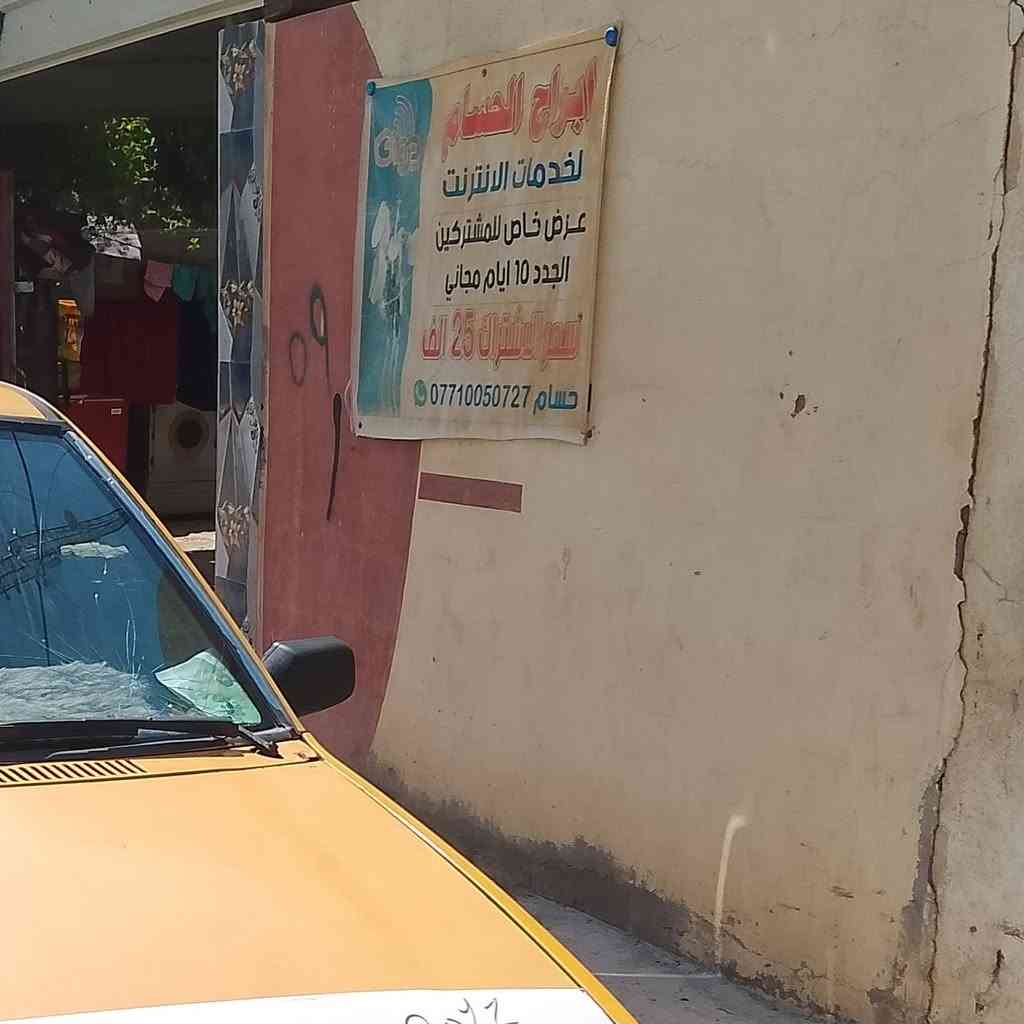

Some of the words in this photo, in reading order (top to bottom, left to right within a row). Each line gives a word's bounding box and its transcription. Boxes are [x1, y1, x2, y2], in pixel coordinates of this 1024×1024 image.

[442, 160, 509, 202] الانترنت
[512, 150, 583, 189] لخدمات
[435, 212, 501, 252] للمشتركين
[504, 211, 541, 246] خاص
[545, 209, 586, 241] عرض
[445, 264, 481, 301] مجاني
[483, 260, 511, 293] ايام
[515, 259, 530, 285] 10
[533, 255, 570, 289] الجدد
[451, 309, 474, 360] 25
[430, 383, 532, 408] 07710050727
[533, 384, 578, 416] حسام
